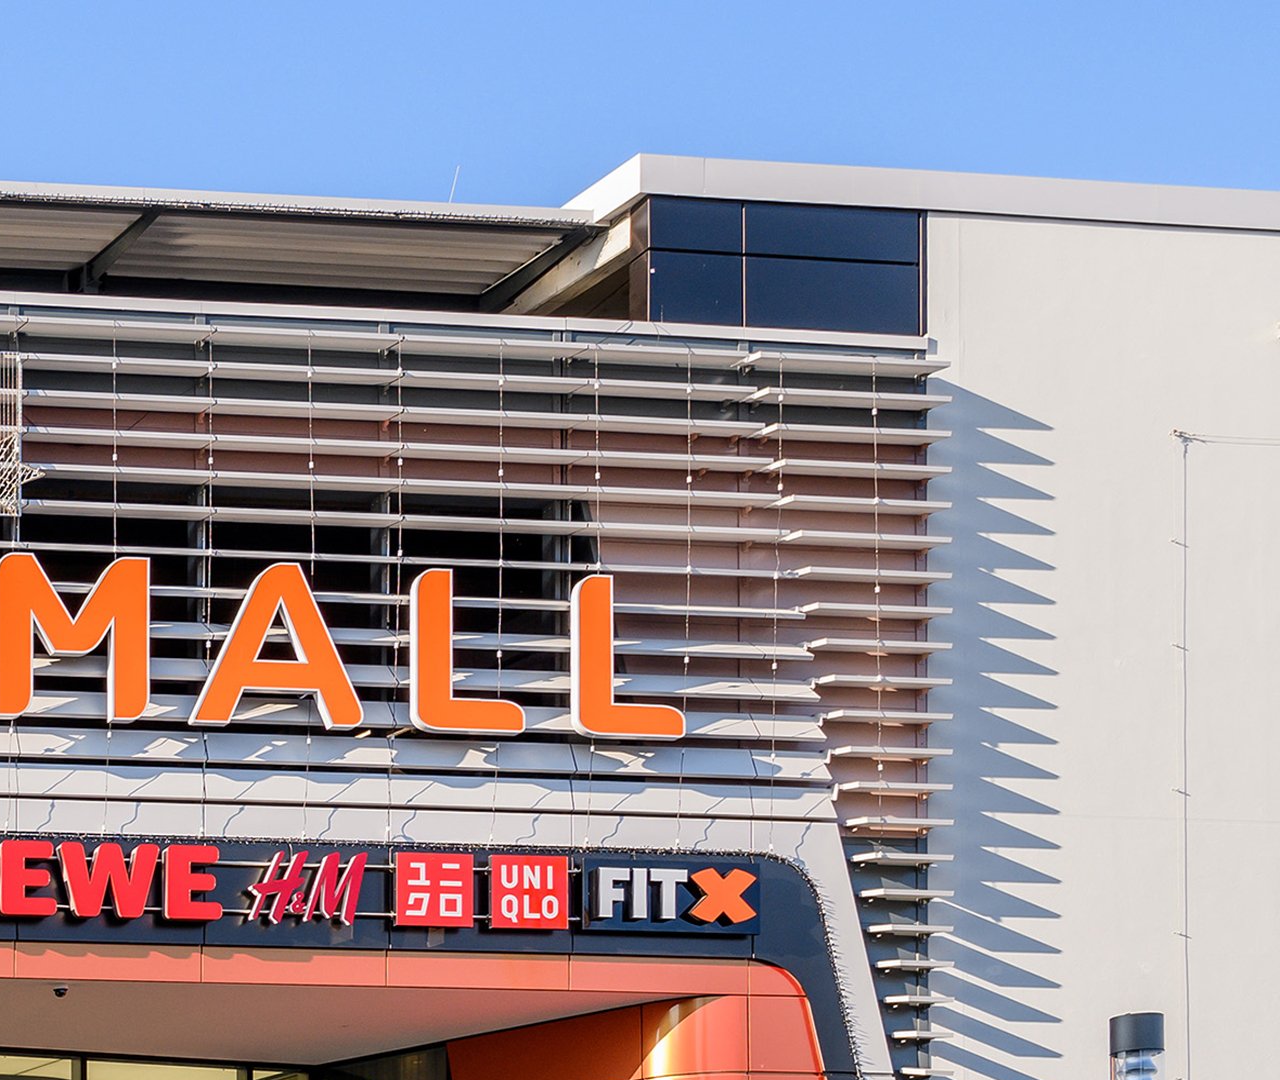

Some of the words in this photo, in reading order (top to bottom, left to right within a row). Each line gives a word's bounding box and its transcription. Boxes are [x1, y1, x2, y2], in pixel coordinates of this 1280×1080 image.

[247, 850, 368, 926] H&M
[500, 863, 555, 890] UNI
[500, 894, 557, 923] QLO
